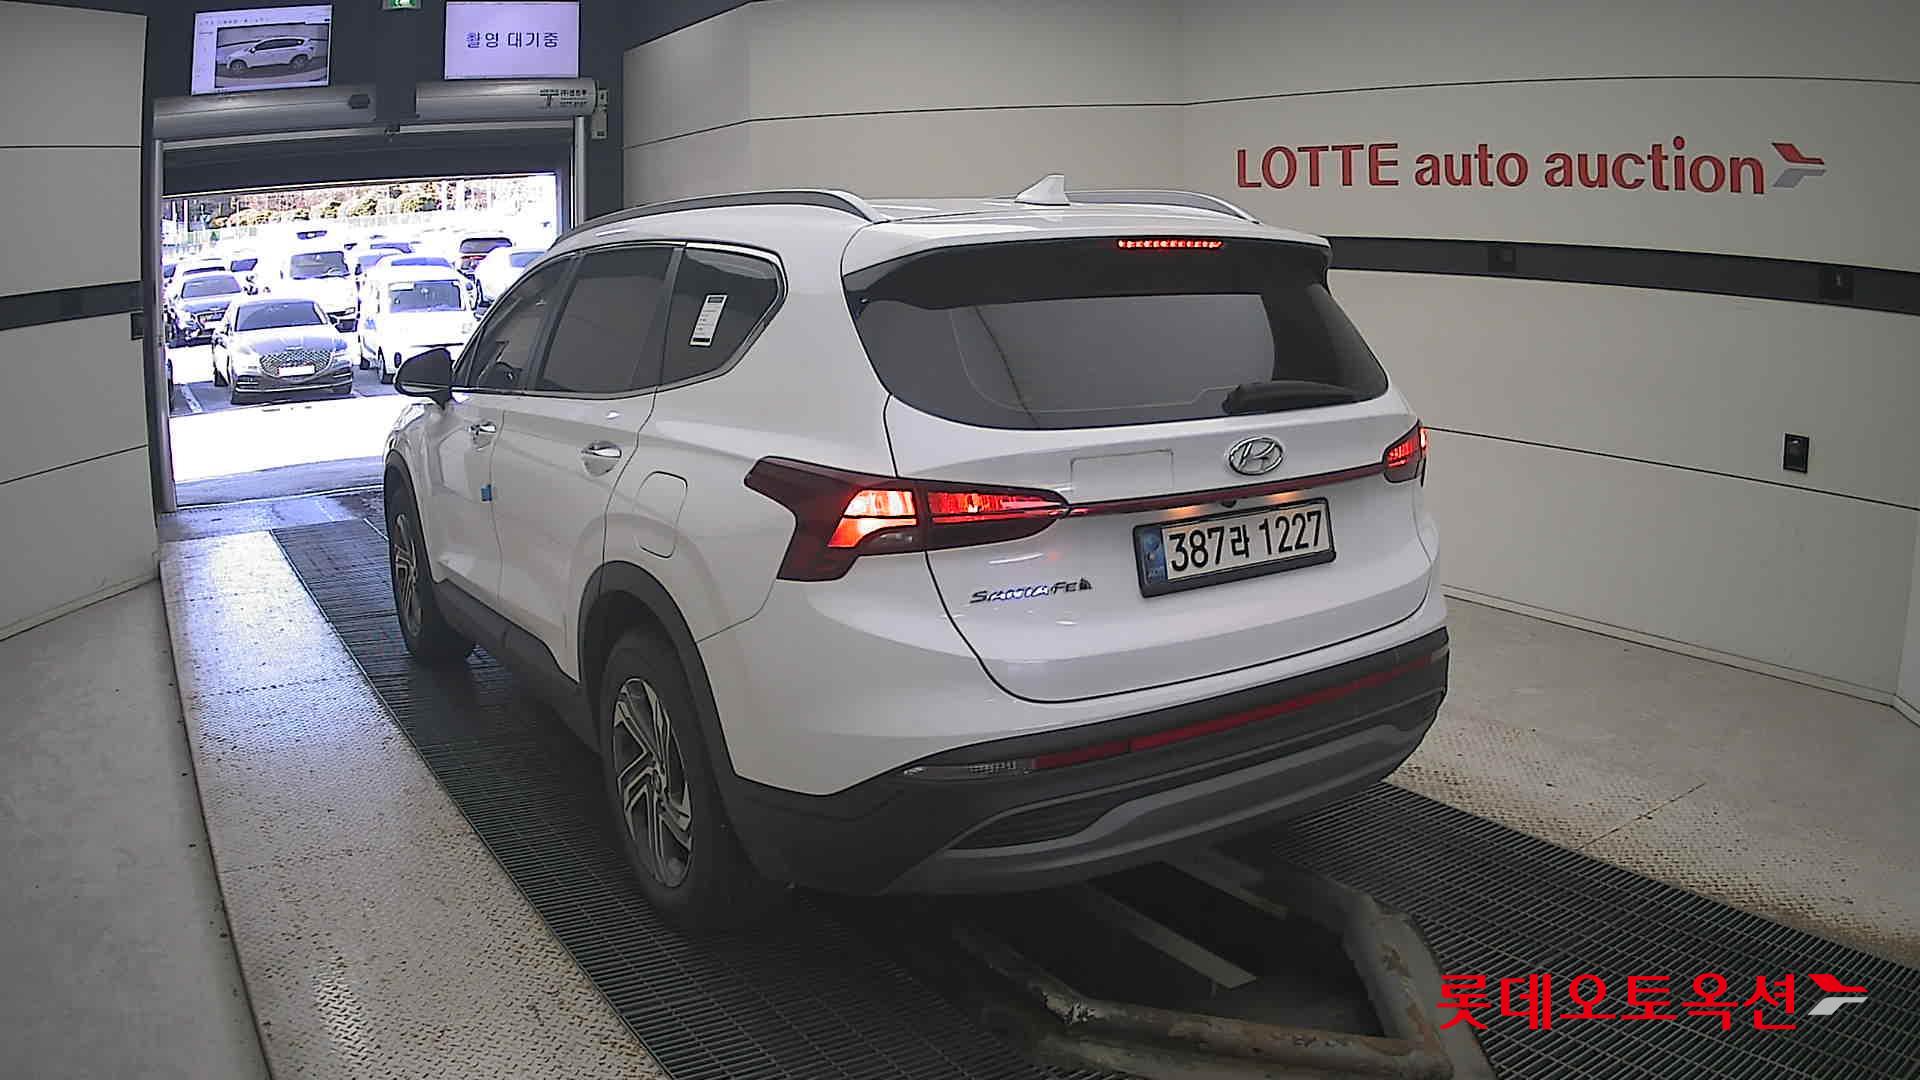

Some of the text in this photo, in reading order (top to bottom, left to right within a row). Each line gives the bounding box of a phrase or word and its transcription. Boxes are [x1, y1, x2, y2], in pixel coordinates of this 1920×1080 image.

[466, 31, 560, 48] 촬영 대기중
[1236, 136, 1766, 195] LOTTE auto auction
[1168, 510, 1322, 572] 387라 1227
